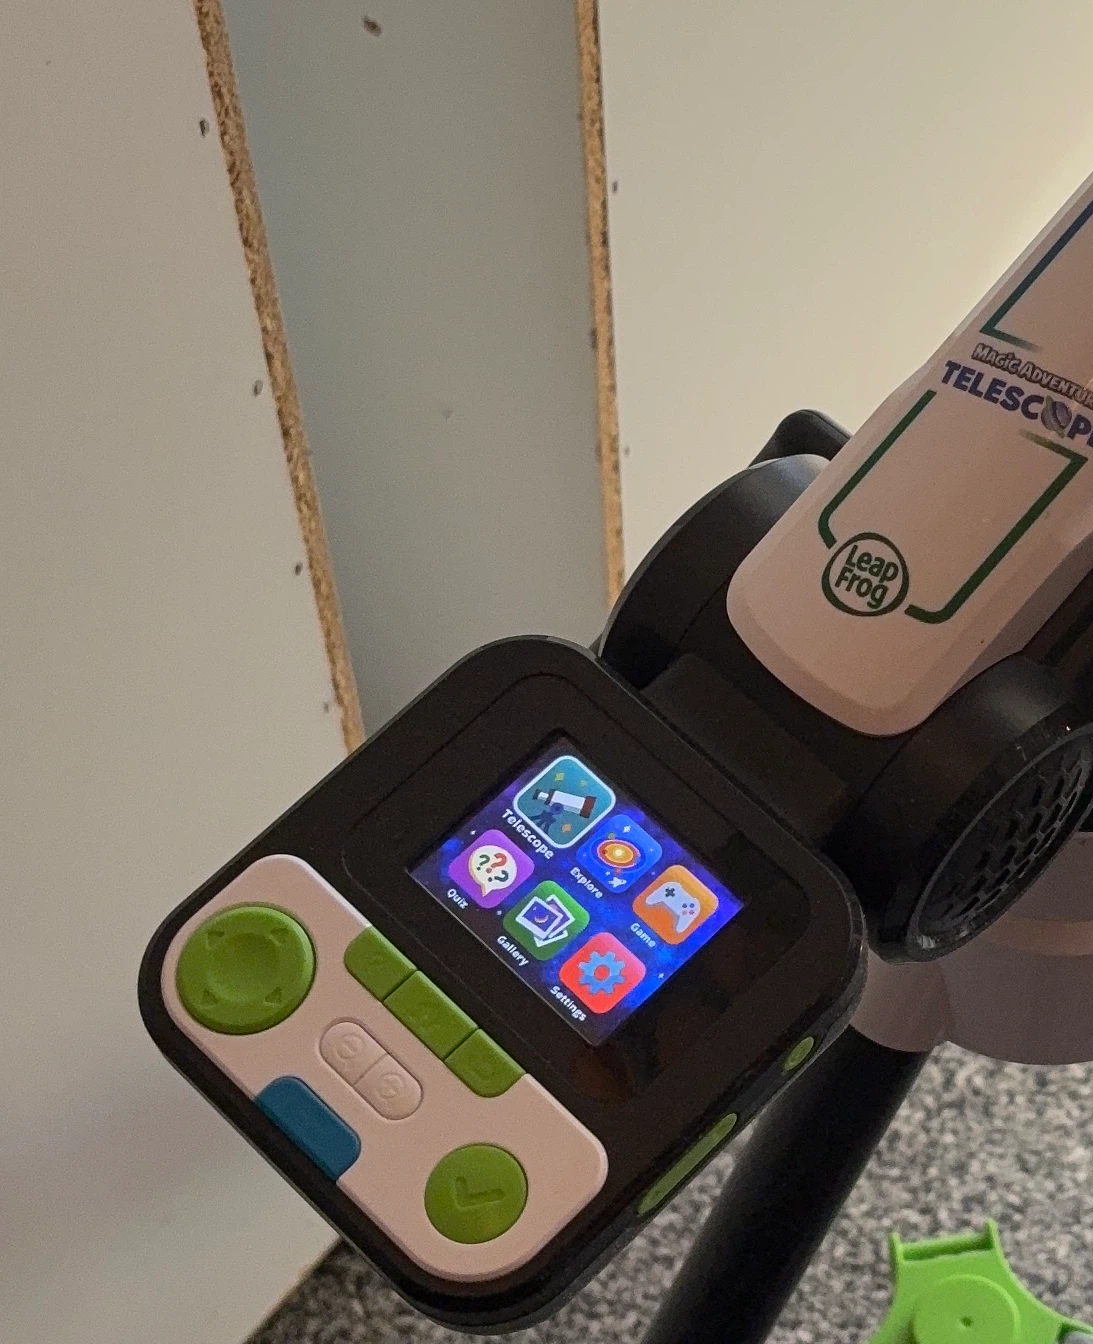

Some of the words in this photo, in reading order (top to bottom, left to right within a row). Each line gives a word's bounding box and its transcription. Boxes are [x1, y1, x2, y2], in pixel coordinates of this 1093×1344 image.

[846, 544, 899, 584] Leap
[834, 567, 890, 610] Frog
[501, 808, 555, 860] Telescope
[446, 887, 469, 910] Quiz
[569, 866, 604, 900] Explore
[497, 935, 529, 966] Gallery
[630, 922, 657, 948] Game
[550, 986, 587, 1022] Settings
